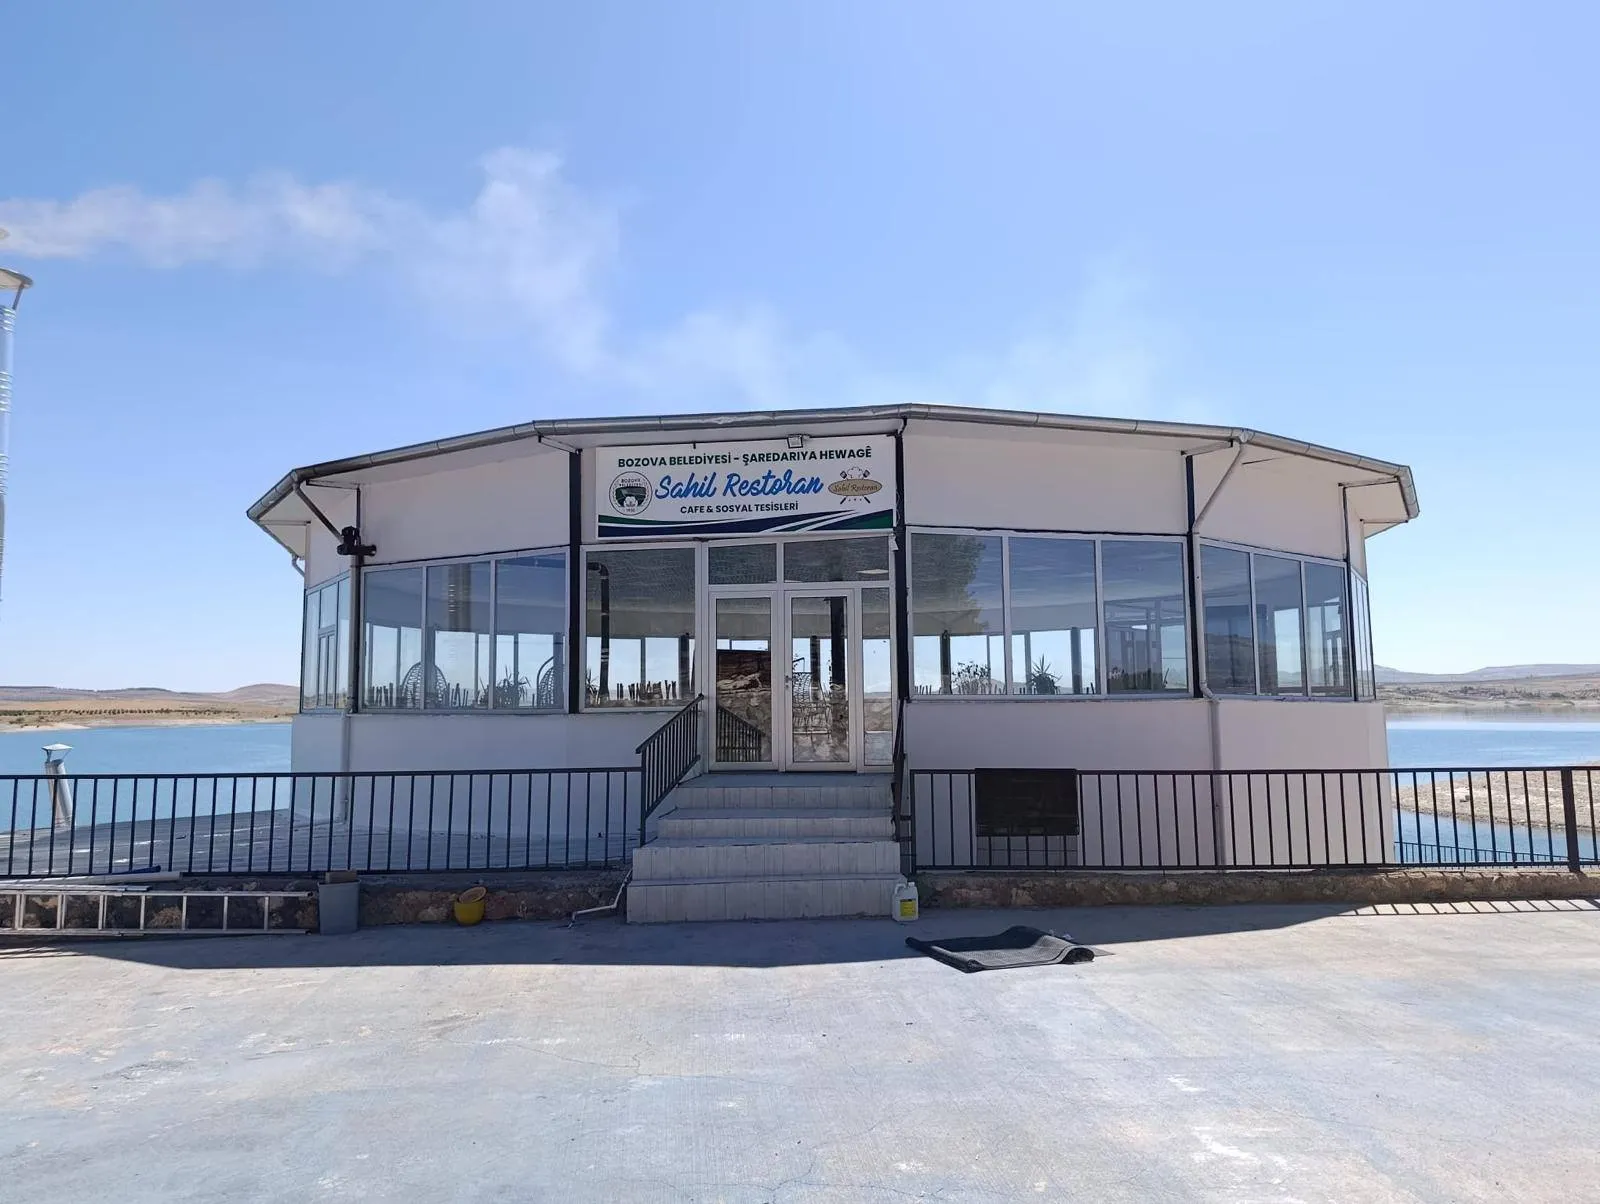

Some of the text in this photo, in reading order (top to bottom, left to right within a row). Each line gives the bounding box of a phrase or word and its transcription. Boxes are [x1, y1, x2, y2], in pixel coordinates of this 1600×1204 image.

[618, 457, 667, 468] BOZOVA
[669, 452, 731, 466] BELEDİYESİ
[742, 450, 817, 466] ŞAREDARIYA
[819, 445, 872, 460] HEWAGÊ
[654, 468, 825, 500] Sahil Restoran
[680, 500, 799, 514] CAFE & SOSYAL TESİSLERİ
